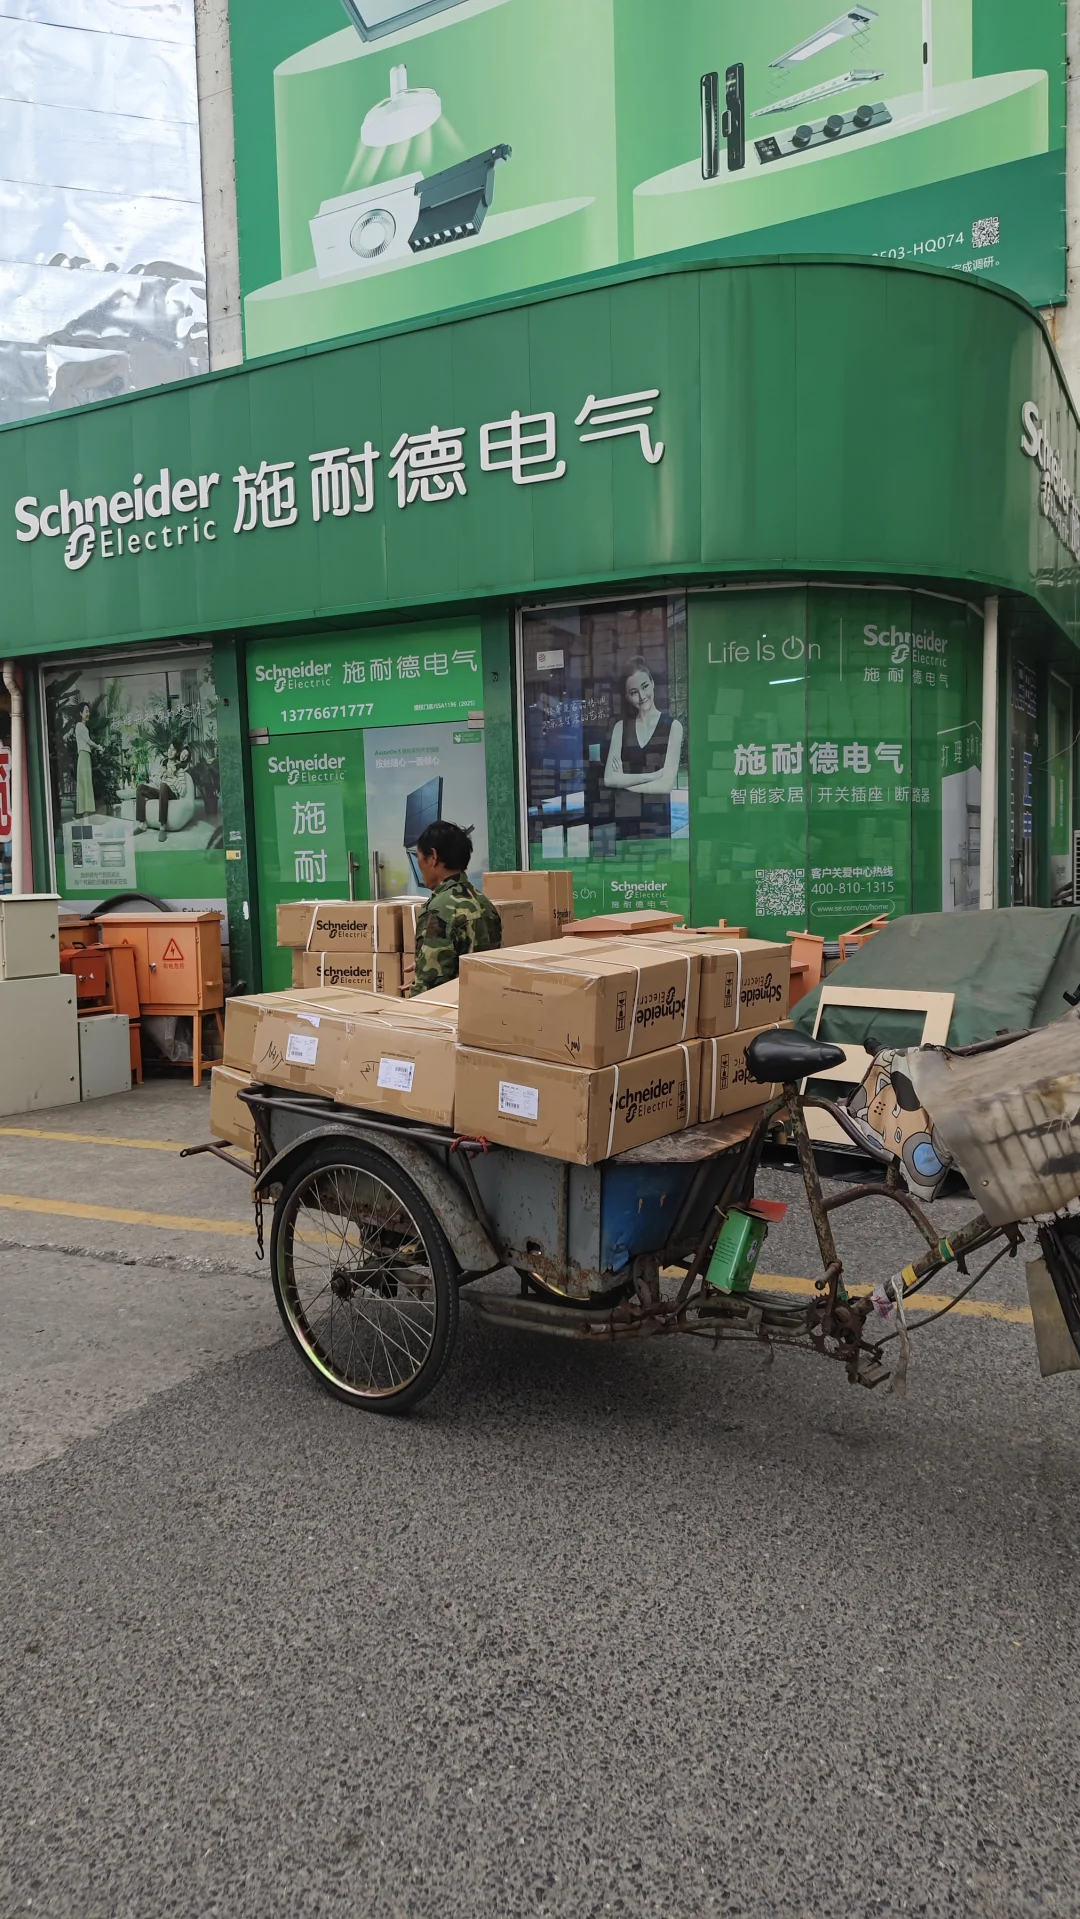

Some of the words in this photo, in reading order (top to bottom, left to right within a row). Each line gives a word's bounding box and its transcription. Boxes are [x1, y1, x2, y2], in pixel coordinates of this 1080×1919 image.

[232, 388, 665, 535] 施耐德电气
[15, 468, 220, 542] Schneider
[101, 516, 218, 559] Electric
[863, 624, 948, 653] Schneider
[708, 642, 750, 663] Life
[757, 640, 776, 661] Is
[782, 635, 821, 660] On
[912, 649, 947, 667] Electric
[255, 660, 332, 681] Schneider
[342, 649, 478, 685] 施耐德电气
[863, 666, 949, 688] 施耐德电气
[288, 678, 331, 690] Electric
[281, 703, 374, 722] 13776671777
[268, 753, 346, 774] Schneider
[733, 741, 905, 776] 施耐德电气
[301, 770, 345, 783] Electric
[730, 786, 804, 805] 智能家居
[817, 785, 883, 803] 开关插座
[895, 786, 930, 803] 断路器
[811, 865, 894, 879] 客户关爱中心热线
[611, 880, 668, 892] Schneider
[635, 891, 667, 899] Electric
[811, 881, 894, 895] 400-810-1315
[611, 901, 669, 909] 施耐德电气
[817, 903, 889, 912] www.se.com/cn/home
[316, 920, 368, 931] Schneider
[316, 965, 372, 977] Schneider
[741, 976, 764, 987] Electri
[740, 984, 782, 1007] Schneide
[609, 1078, 675, 1112] Schneider
[638, 1097, 673, 1117] Electric
